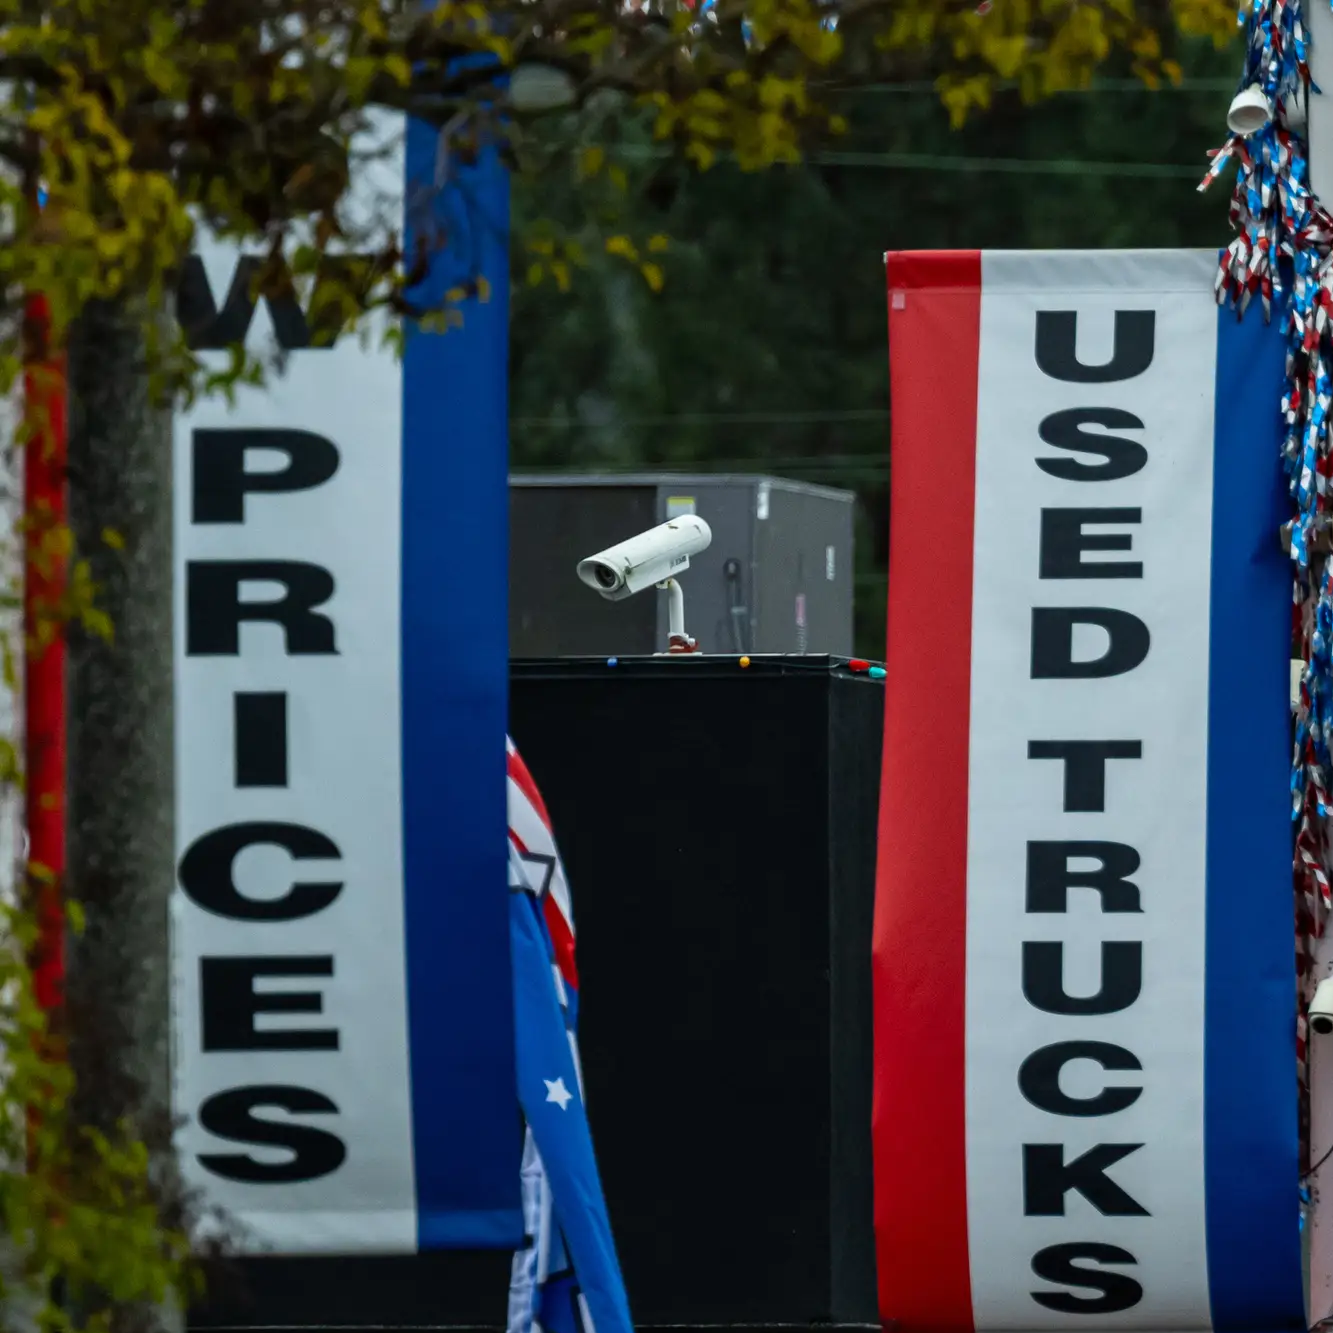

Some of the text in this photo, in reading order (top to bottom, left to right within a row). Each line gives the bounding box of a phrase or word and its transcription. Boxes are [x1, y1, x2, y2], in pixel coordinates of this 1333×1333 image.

[177, 427, 348, 1183] PRICES
[1017, 310, 1156, 1314] USED TRUCKS
